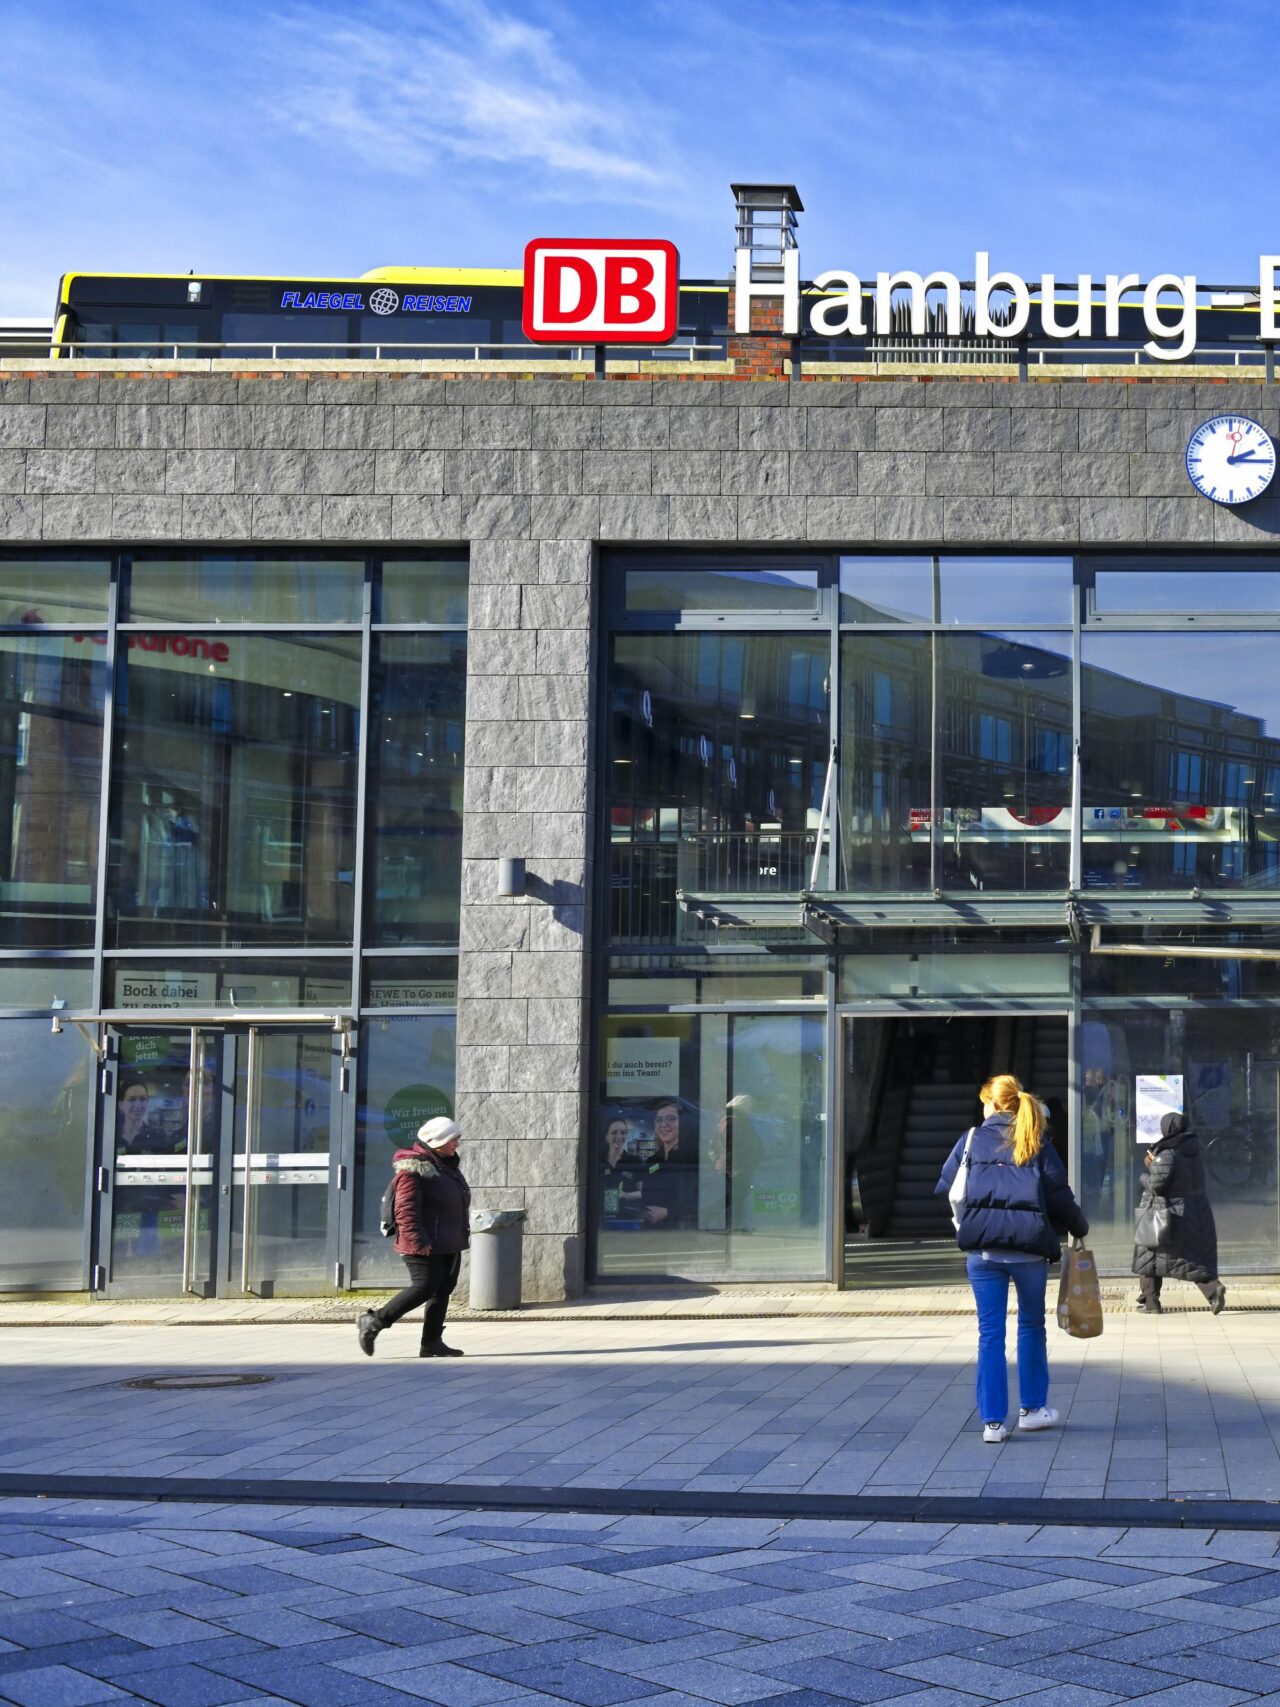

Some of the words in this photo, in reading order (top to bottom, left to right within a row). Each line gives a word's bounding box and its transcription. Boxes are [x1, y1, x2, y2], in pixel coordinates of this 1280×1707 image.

[542, 255, 656, 324] DB
[280, 291, 365, 310] FLAEGEL
[402, 294, 473, 312] REISEN
[122, 984, 157, 998] Bock
[161, 985, 198, 999] dabei
[402, 989, 416, 999] To
[418, 989, 433, 999] Go
[435, 991, 455, 999] neu
[135, 1041, 156, 1050] dich
[612, 1061, 622, 1069] du
[624, 1061, 643, 1069] auch
[645, 1060, 672, 1069] bereit?
[636, 1069, 660, 1077] Team!
[391, 1107, 410, 1118] Wir
[412, 1105, 447, 1116] freuen
